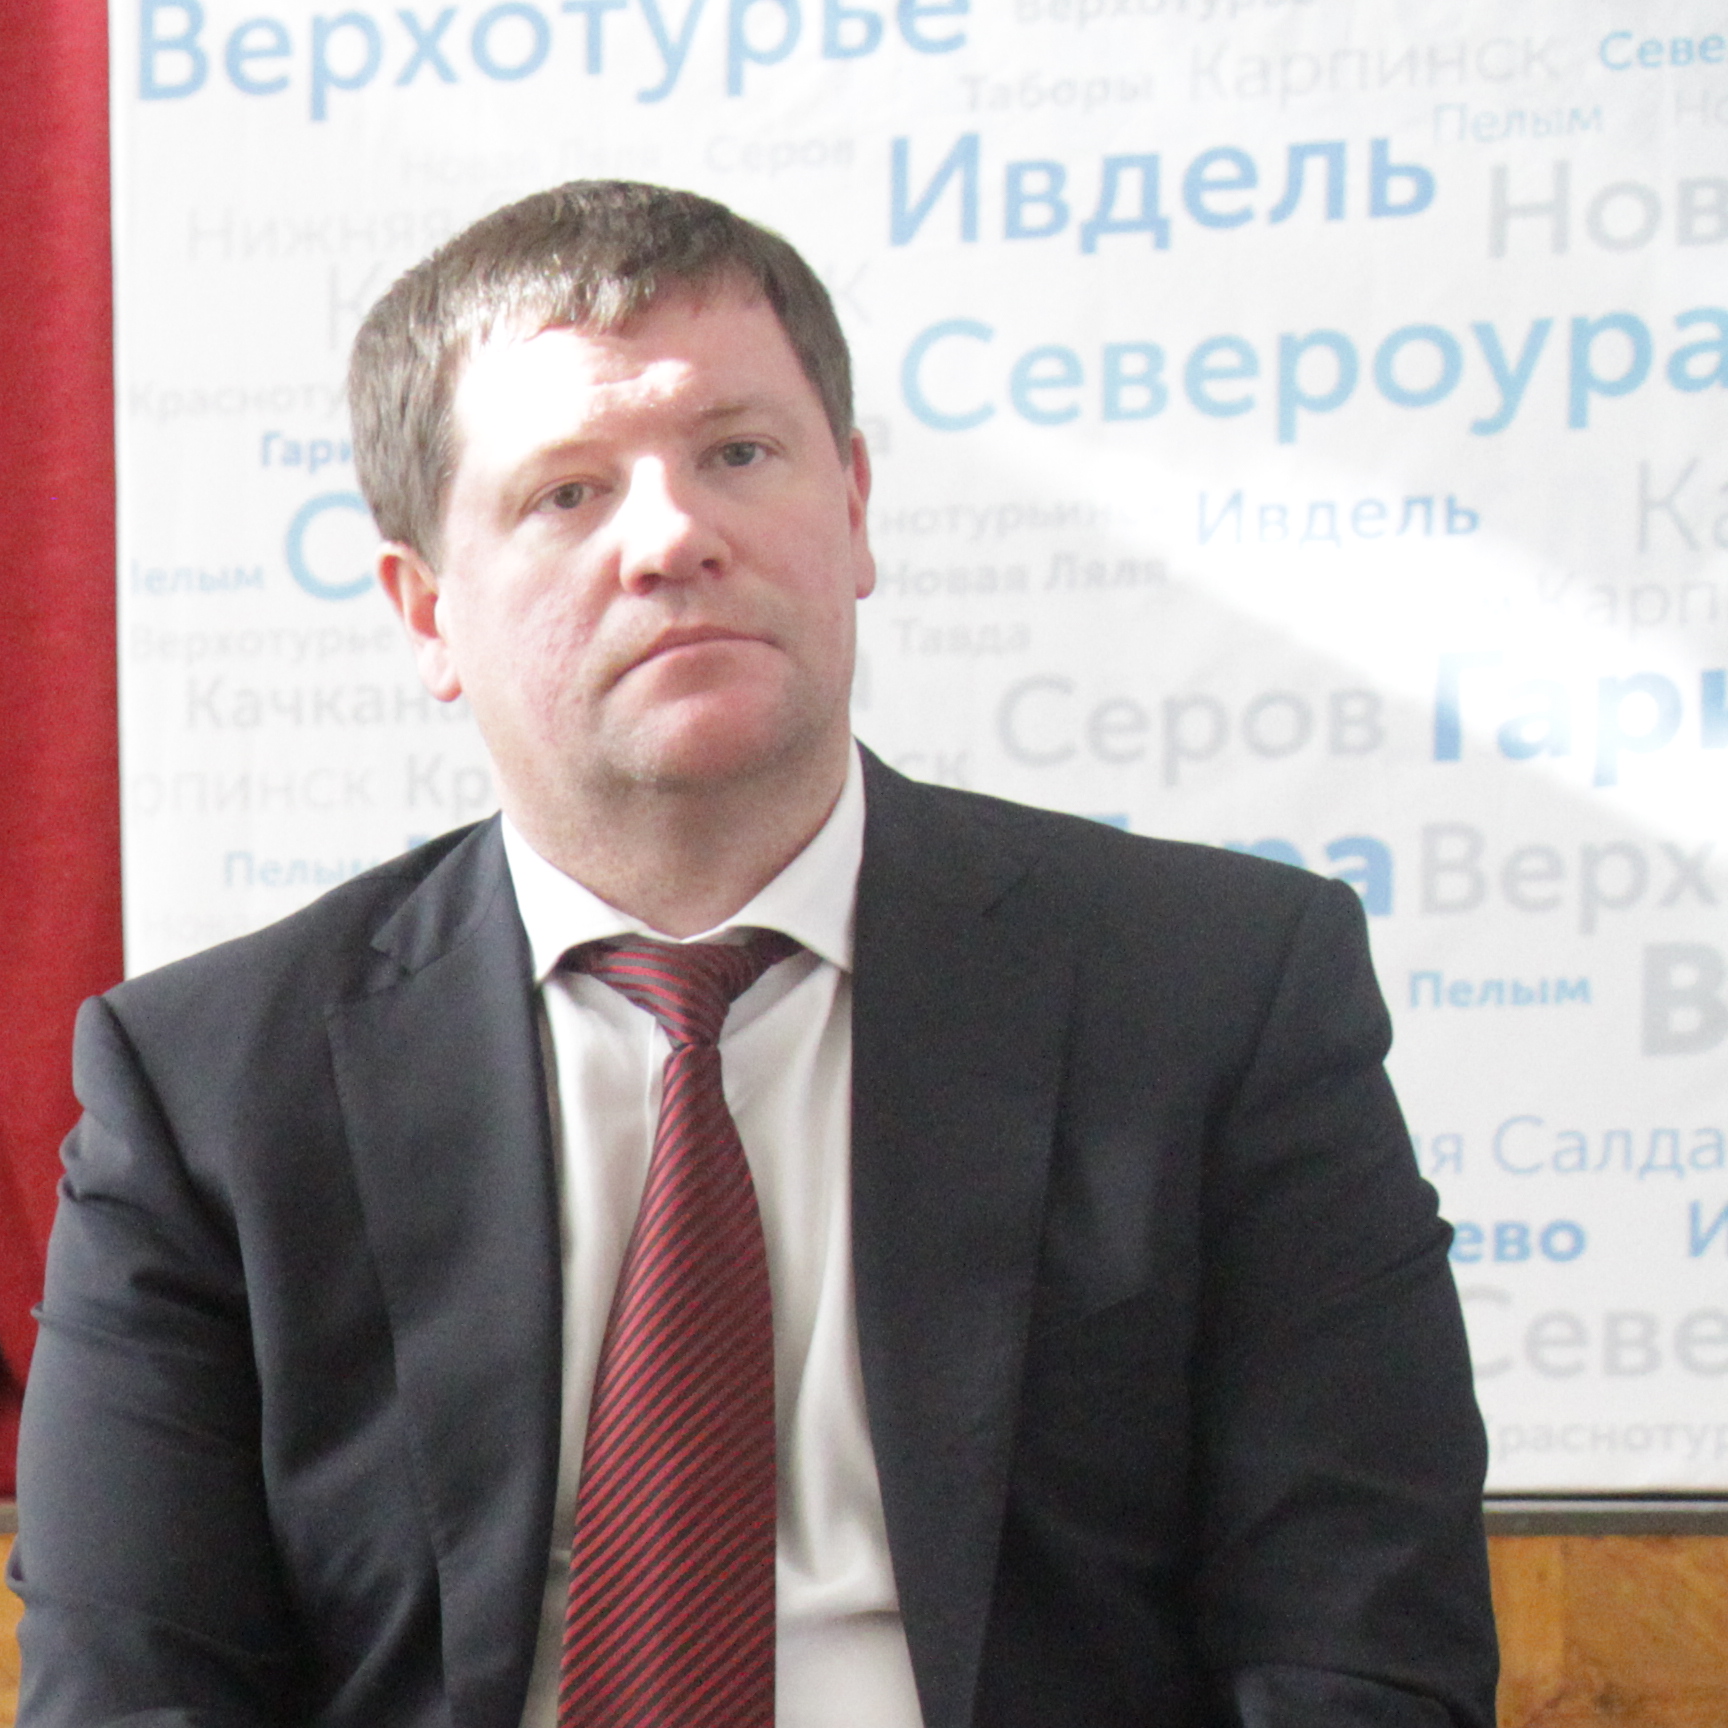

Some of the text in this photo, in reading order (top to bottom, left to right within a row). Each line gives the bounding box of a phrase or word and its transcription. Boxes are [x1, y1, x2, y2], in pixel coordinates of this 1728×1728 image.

[138, 0, 971, 123] Верхотурье
[1188, 36, 1562, 108] Карпинск
[1598, 29, 1728, 72] Севе
[960, 70, 1155, 113] Таборы
[1432, 103, 1604, 146] Пелым
[889, 132, 1437, 254] Ивдель
[1488, 158, 1728, 260] Нов
[900, 306, 1728, 445] Североура
[1197, 488, 1481, 548] Ивдель
[131, 561, 265, 598] елым
[1044, 550, 1169, 592] Ляля
[129, 622, 396, 667] Верхотурье
[891, 617, 1032, 657] Тавда
[996, 674, 1386, 788] Серов
[1408, 969, 1592, 1010] Пелым
[1492, 1114, 1728, 1180] Салда
